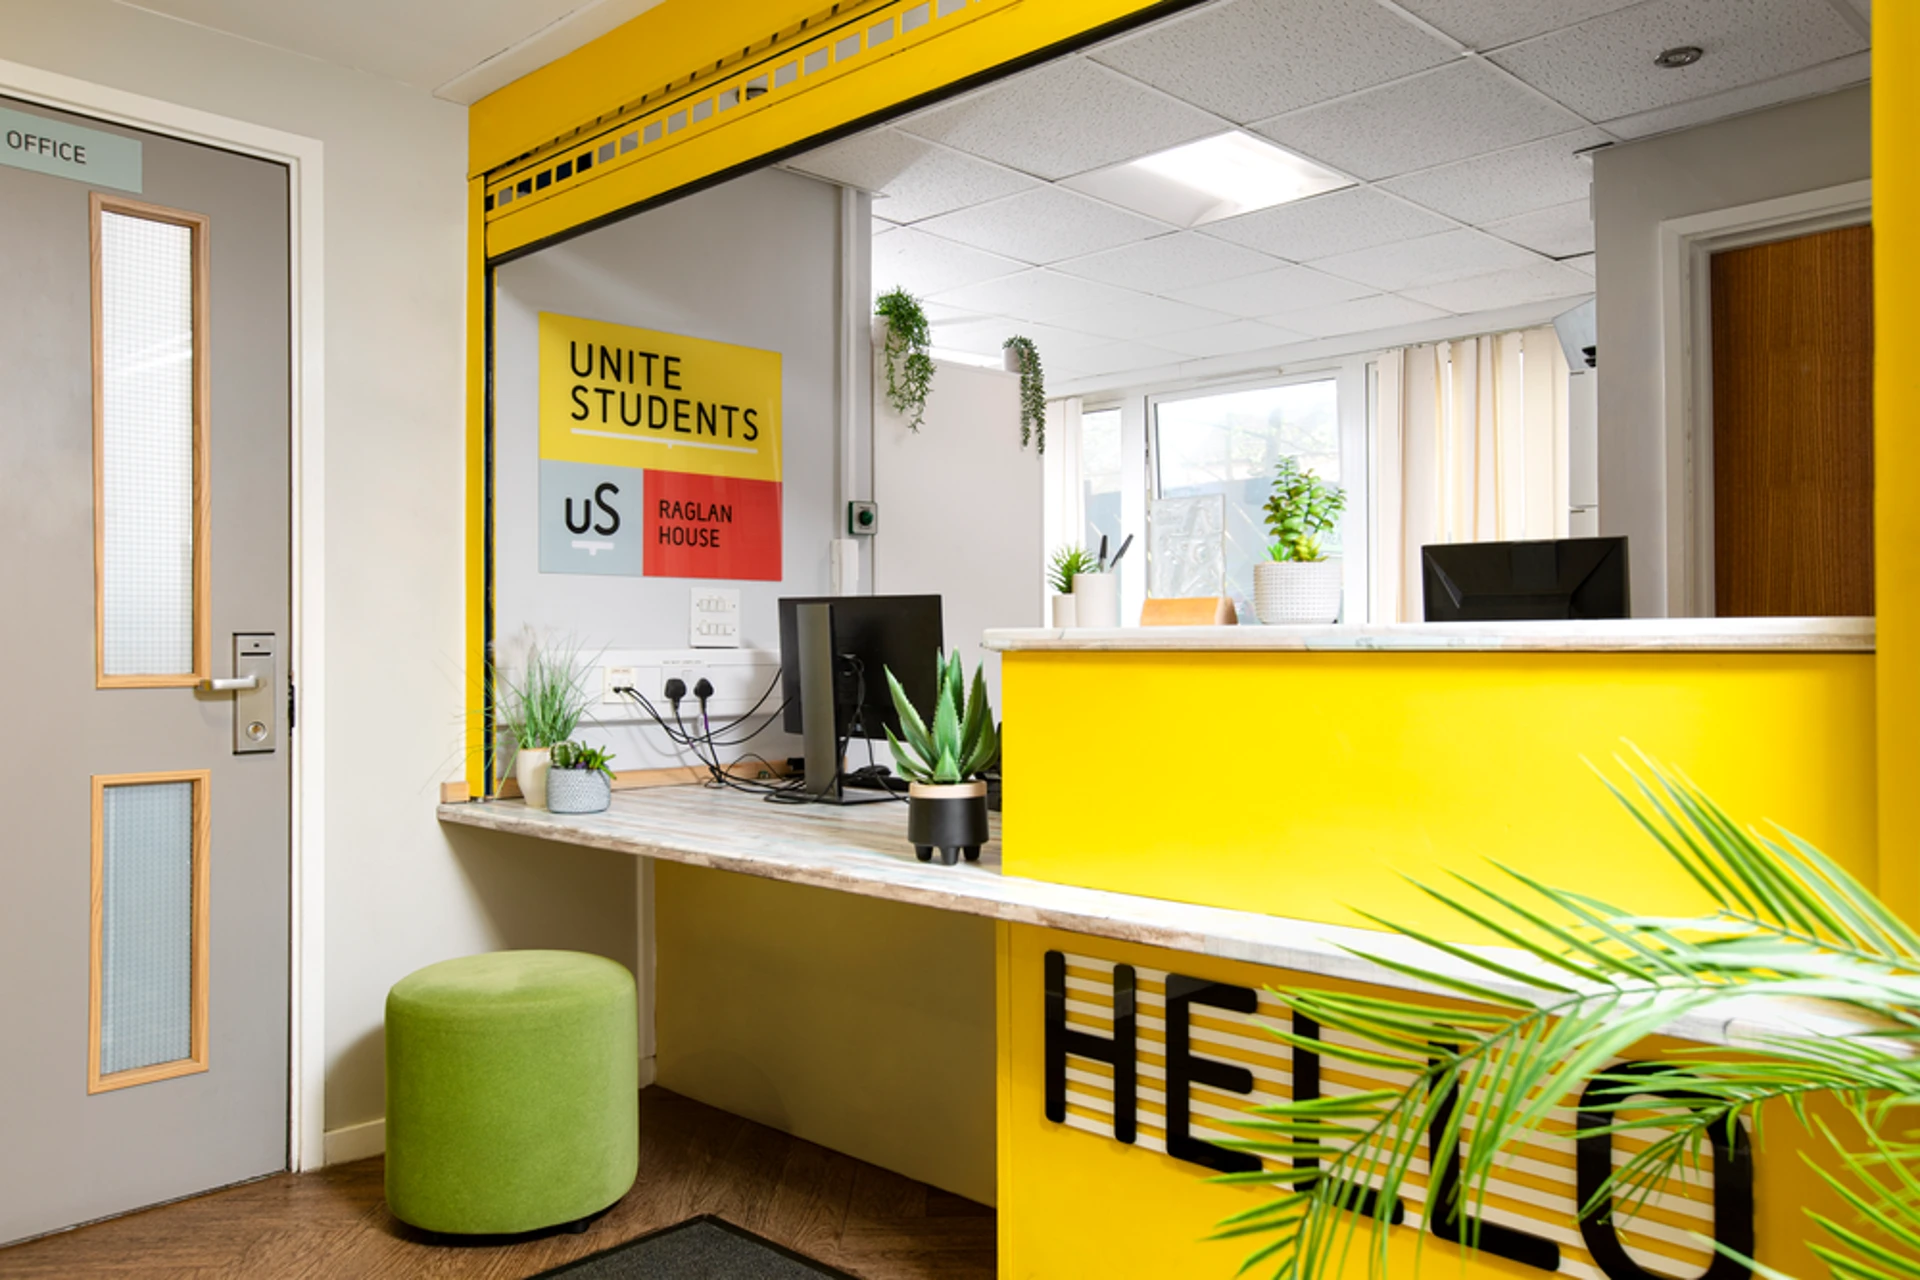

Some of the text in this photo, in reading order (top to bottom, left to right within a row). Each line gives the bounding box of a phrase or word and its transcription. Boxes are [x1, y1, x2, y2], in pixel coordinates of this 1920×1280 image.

[6, 130, 87, 164] OFFICE
[570, 341, 682, 390] UNITE
[571, 385, 759, 441] STUDENTS
[659, 499, 733, 523] RAGLAN
[659, 526, 721, 548] HOUSE
